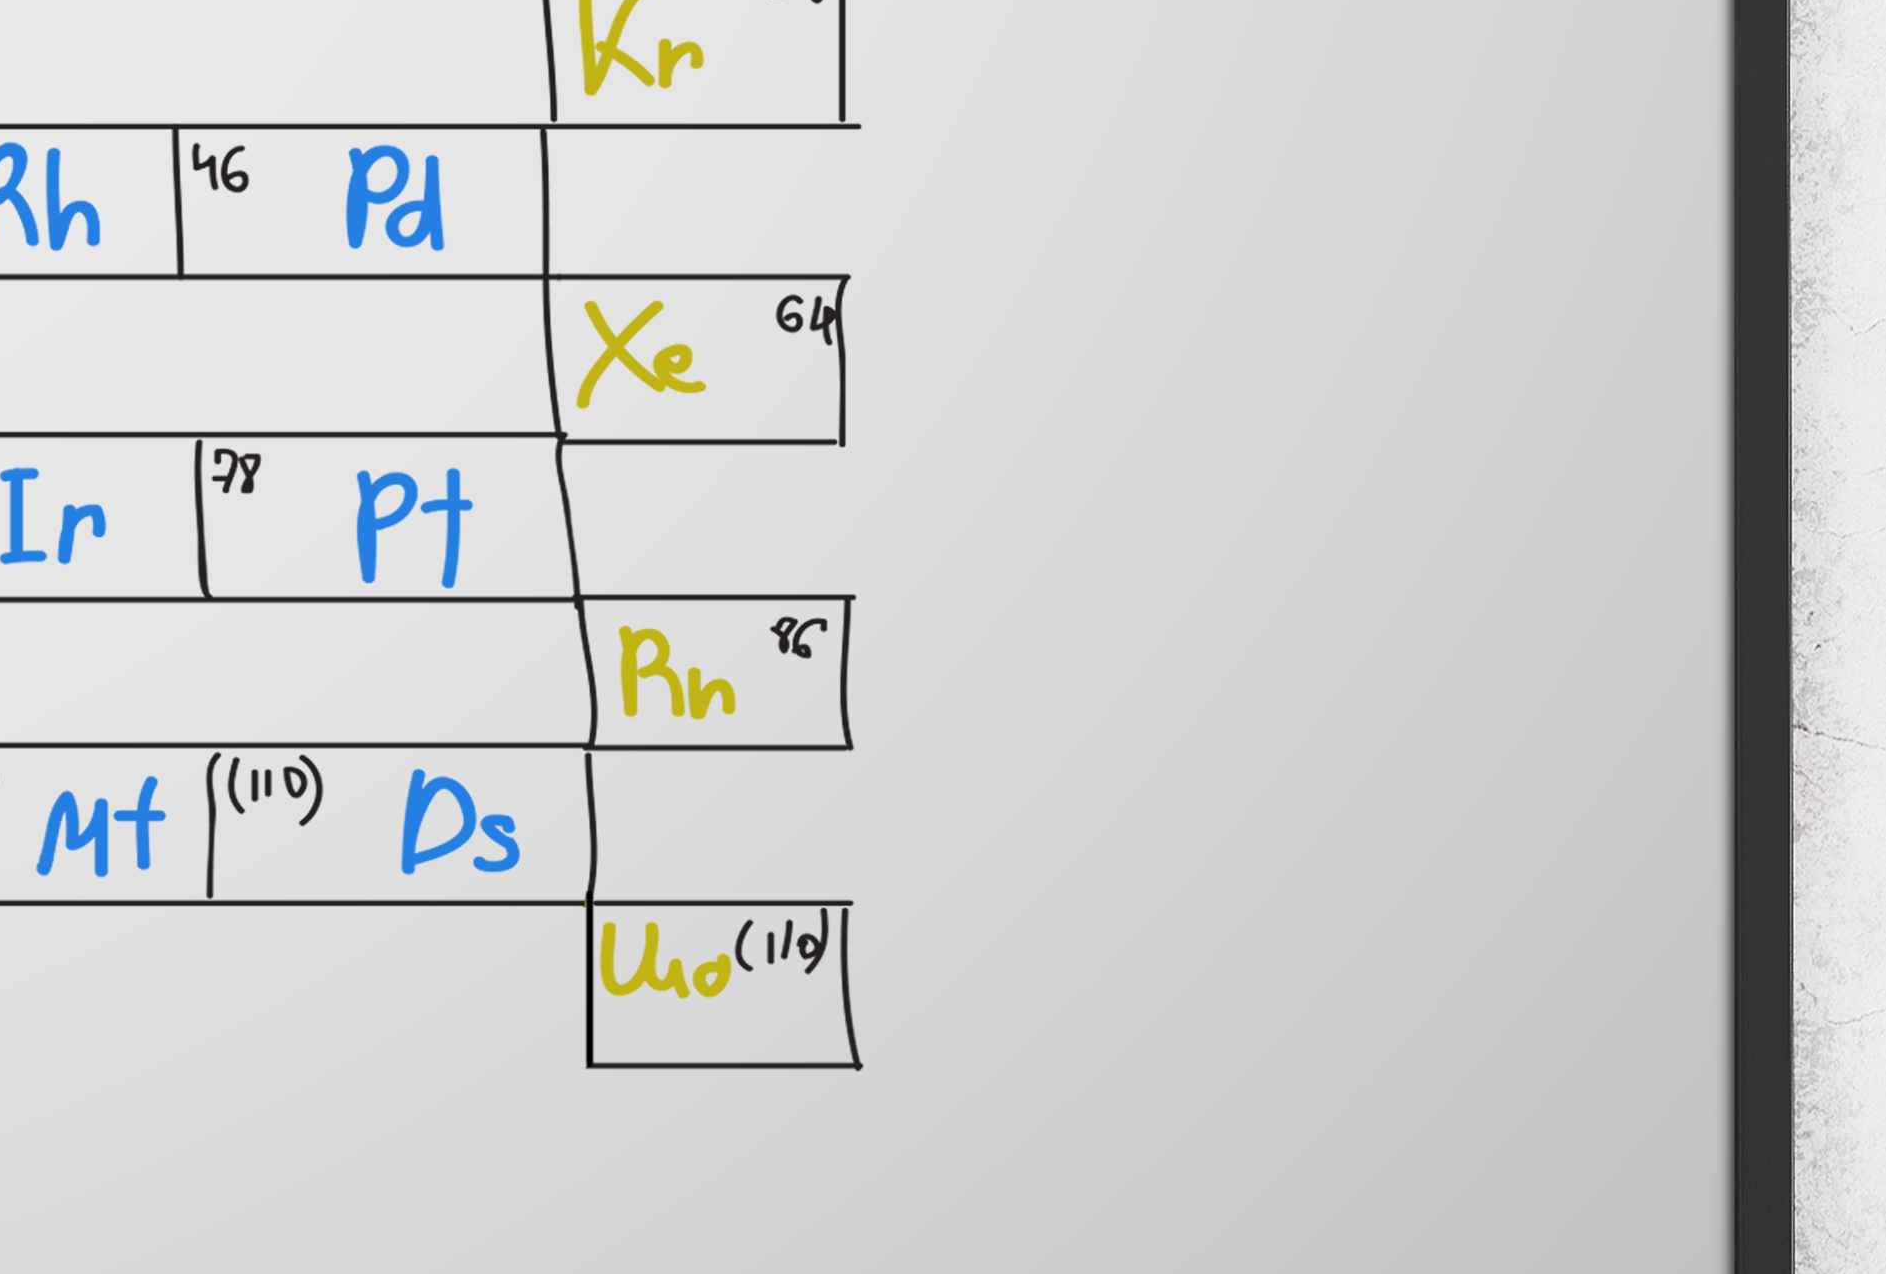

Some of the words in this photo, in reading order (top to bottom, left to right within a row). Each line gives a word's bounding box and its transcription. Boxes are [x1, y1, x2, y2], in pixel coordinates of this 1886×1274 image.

[192, 143, 249, 193] 46
[345, 144, 445, 252] Pd
[576, 300, 707, 410] Xe
[0, 467, 107, 565] Ir
[212, 448, 262, 494] 78
[356, 468, 474, 589] Pt
[618, 624, 736, 721] Rn
[36, 775, 166, 878] Mt
[400, 768, 521, 876] Ds
